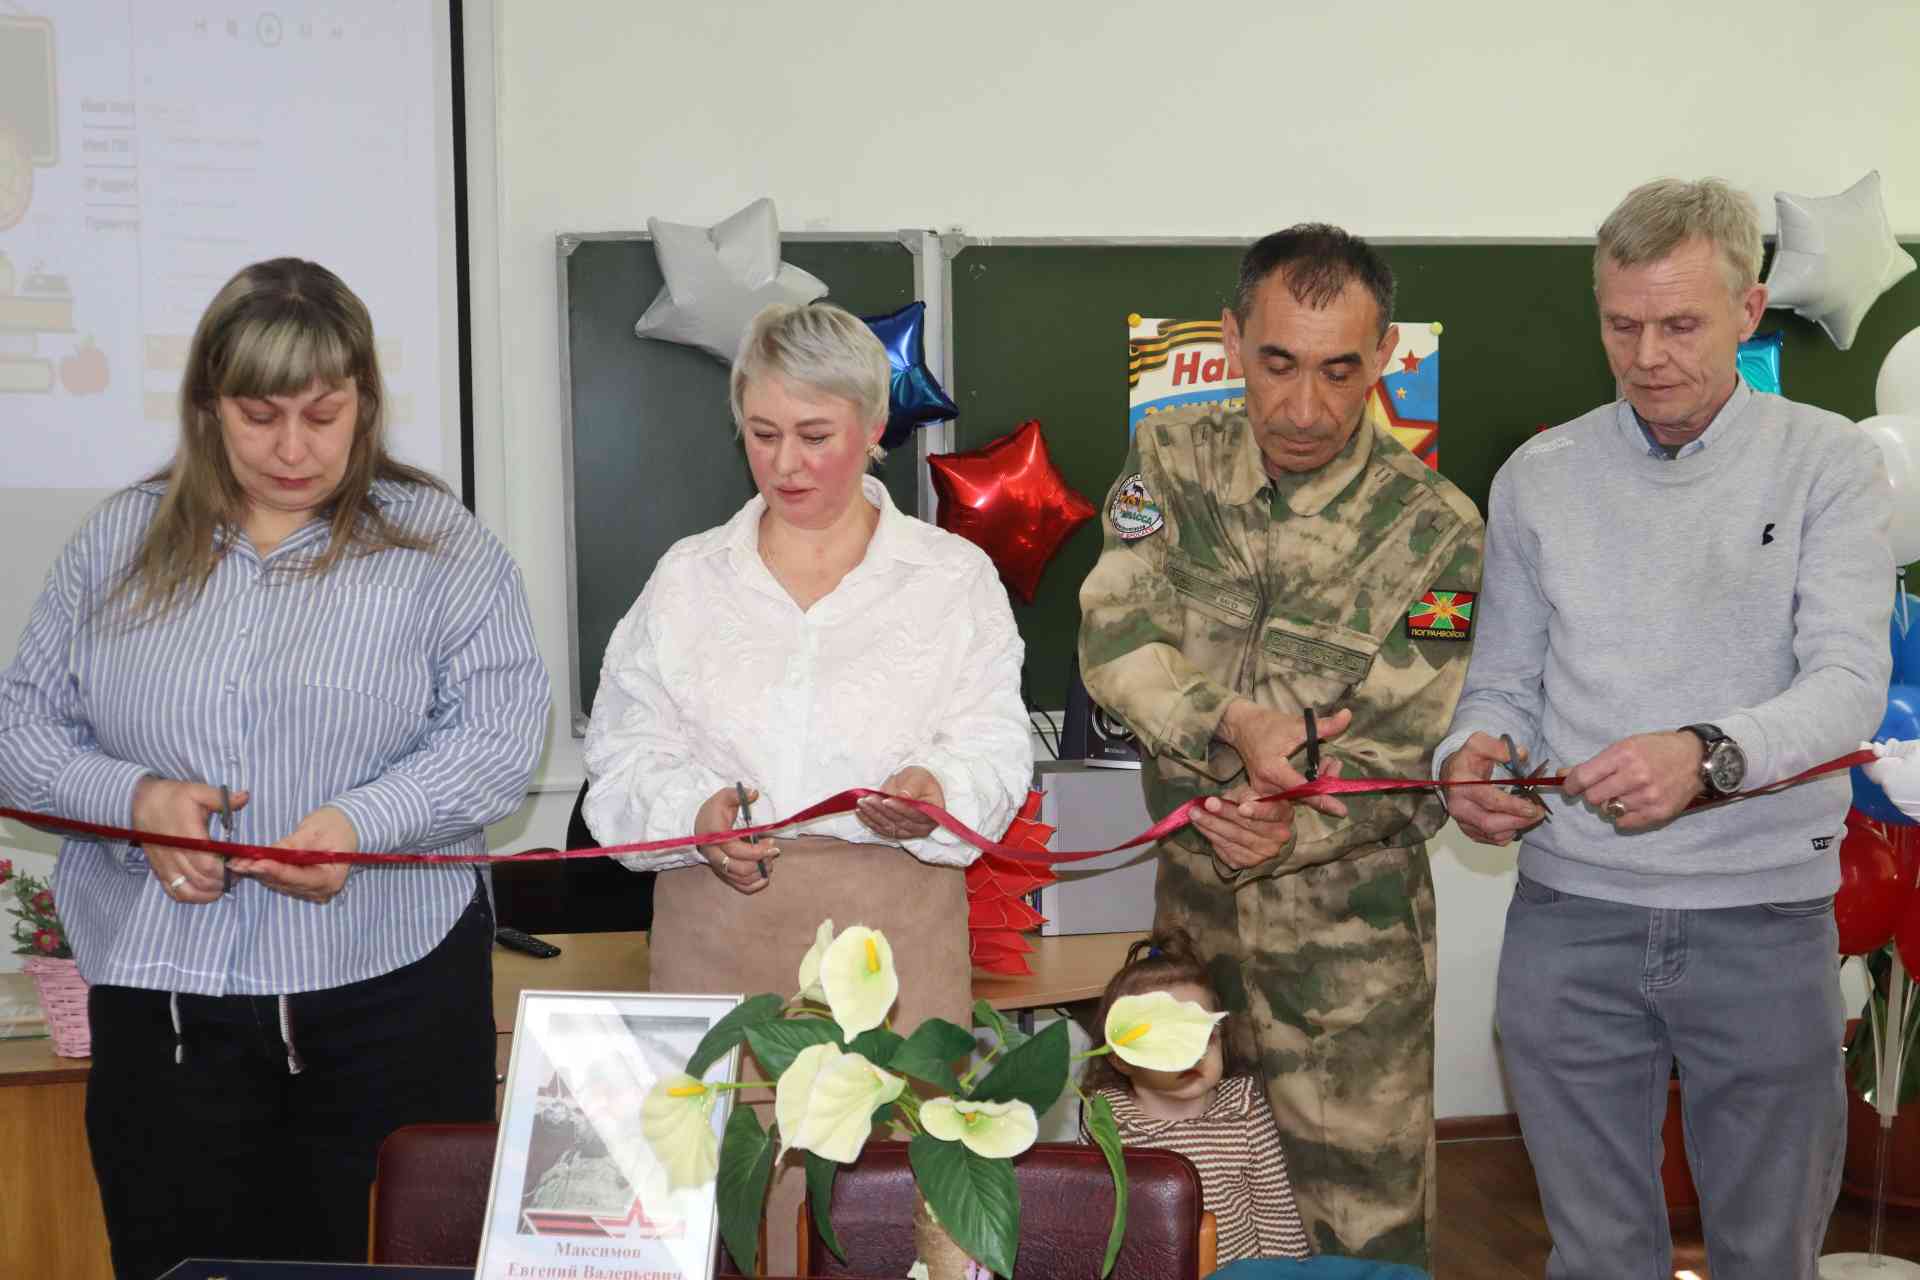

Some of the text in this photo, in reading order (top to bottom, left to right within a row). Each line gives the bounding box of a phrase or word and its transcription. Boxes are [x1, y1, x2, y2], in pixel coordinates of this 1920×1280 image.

[554, 1242, 641, 1260] Максимов
[507, 1262, 683, 1280] Евгений Валерьевич
